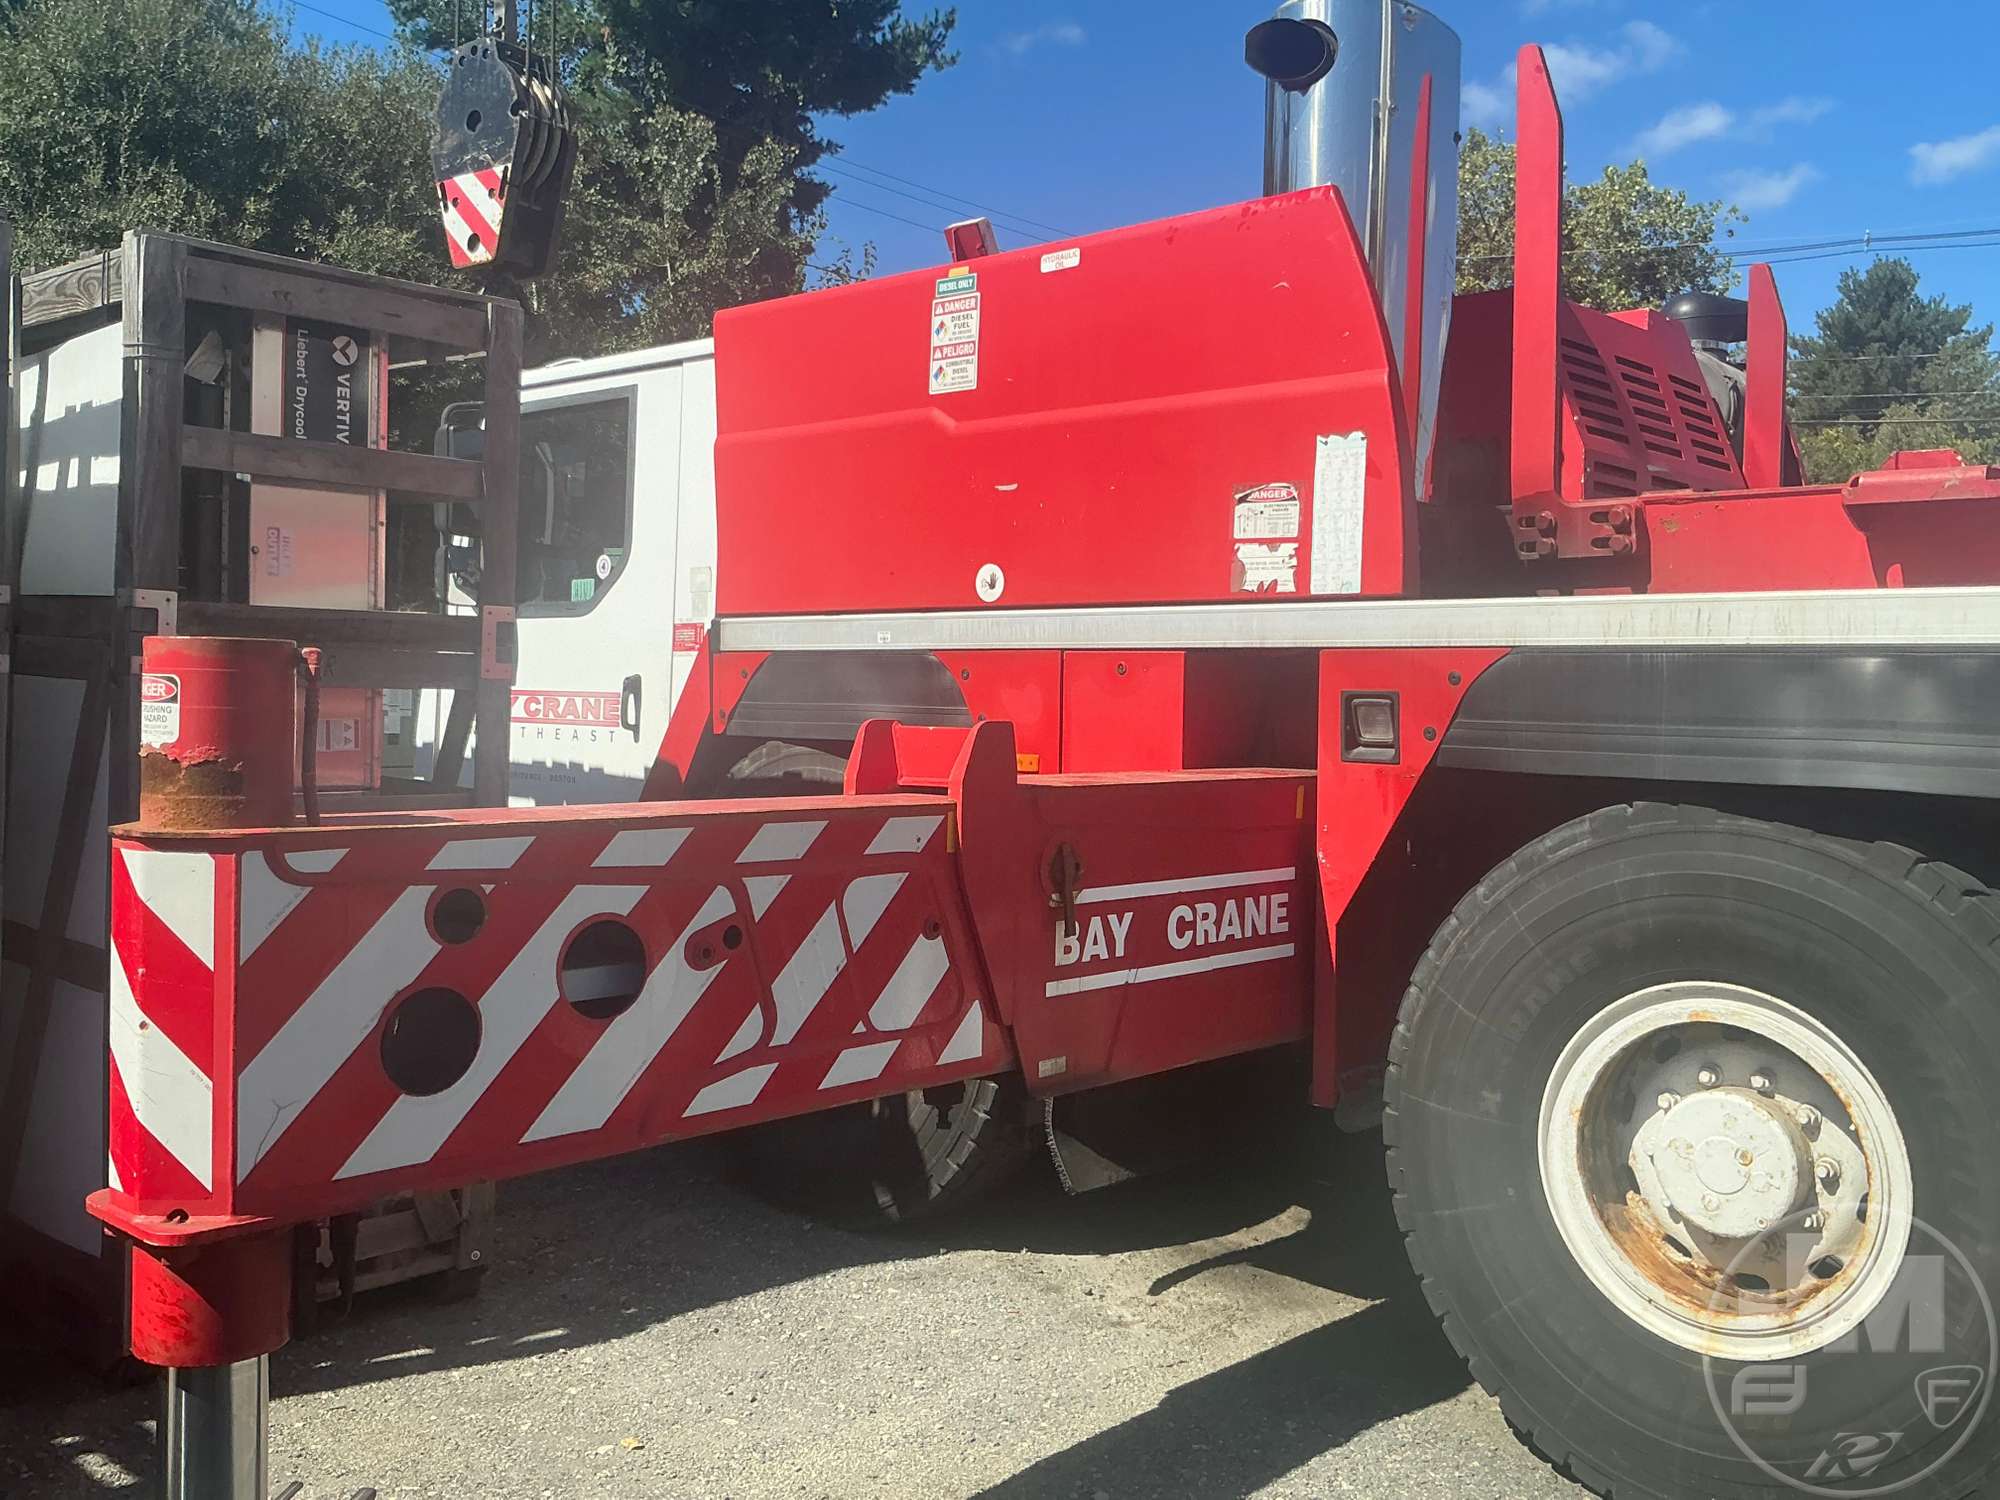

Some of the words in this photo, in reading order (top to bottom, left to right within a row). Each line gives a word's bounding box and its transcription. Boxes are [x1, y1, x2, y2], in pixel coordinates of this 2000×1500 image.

[957, 278, 974, 289] ONLY
[944, 298, 976, 312] DANGER
[951, 313, 974, 322] DIESEL
[953, 321, 970, 329] FUEL
[943, 343, 975, 358] PELIGRO
[292, 386, 308, 440] Drycool
[336, 373, 351, 445] VERTIV
[523, 696, 620, 721] CRANE
[1055, 911, 1134, 967] BAY
[1167, 892, 1289, 950] CRANE
